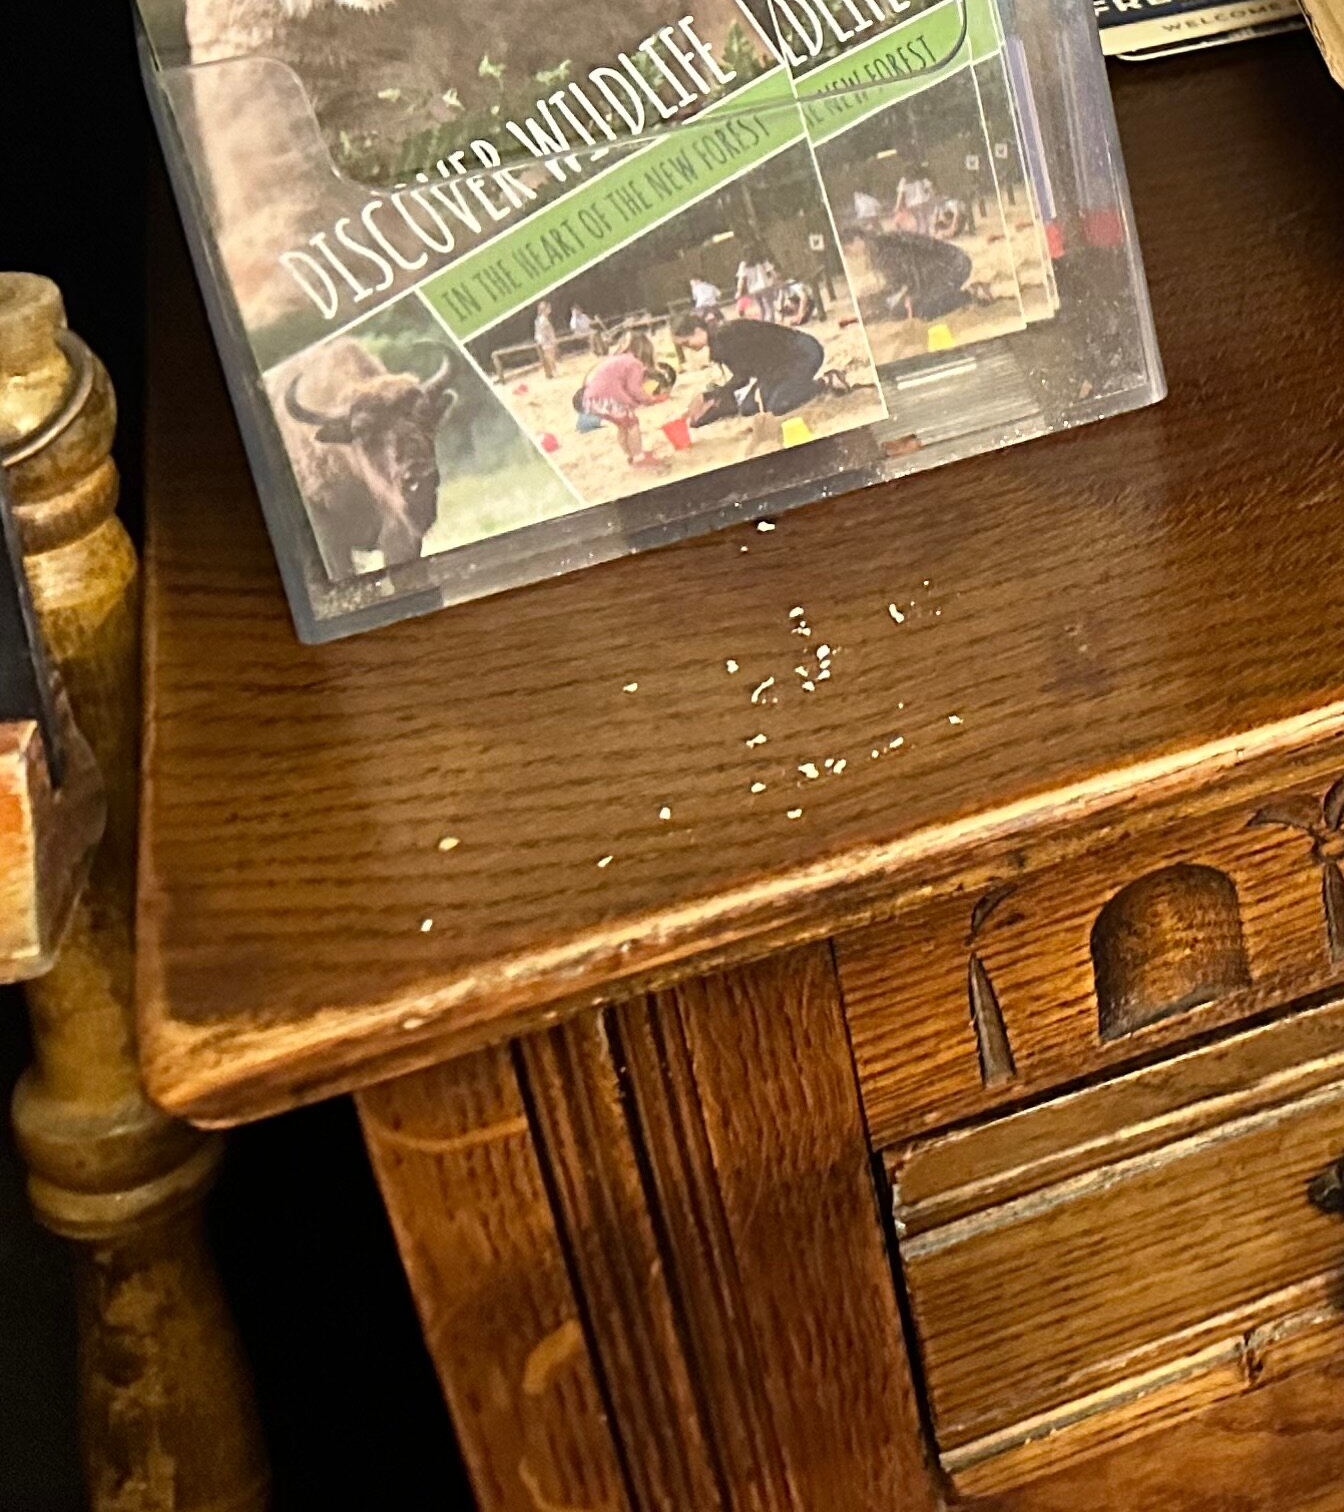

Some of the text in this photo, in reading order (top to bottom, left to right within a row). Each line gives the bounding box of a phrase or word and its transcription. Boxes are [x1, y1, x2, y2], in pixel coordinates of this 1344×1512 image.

[864, 35, 937, 91] FOREST
[1161, 1, 1283, 33] WELCOME
[278, 14, 737, 322] DISCOVER WILDLIFE
[440, 114, 772, 323] IN THE HEART OF THE NEW FOREST
